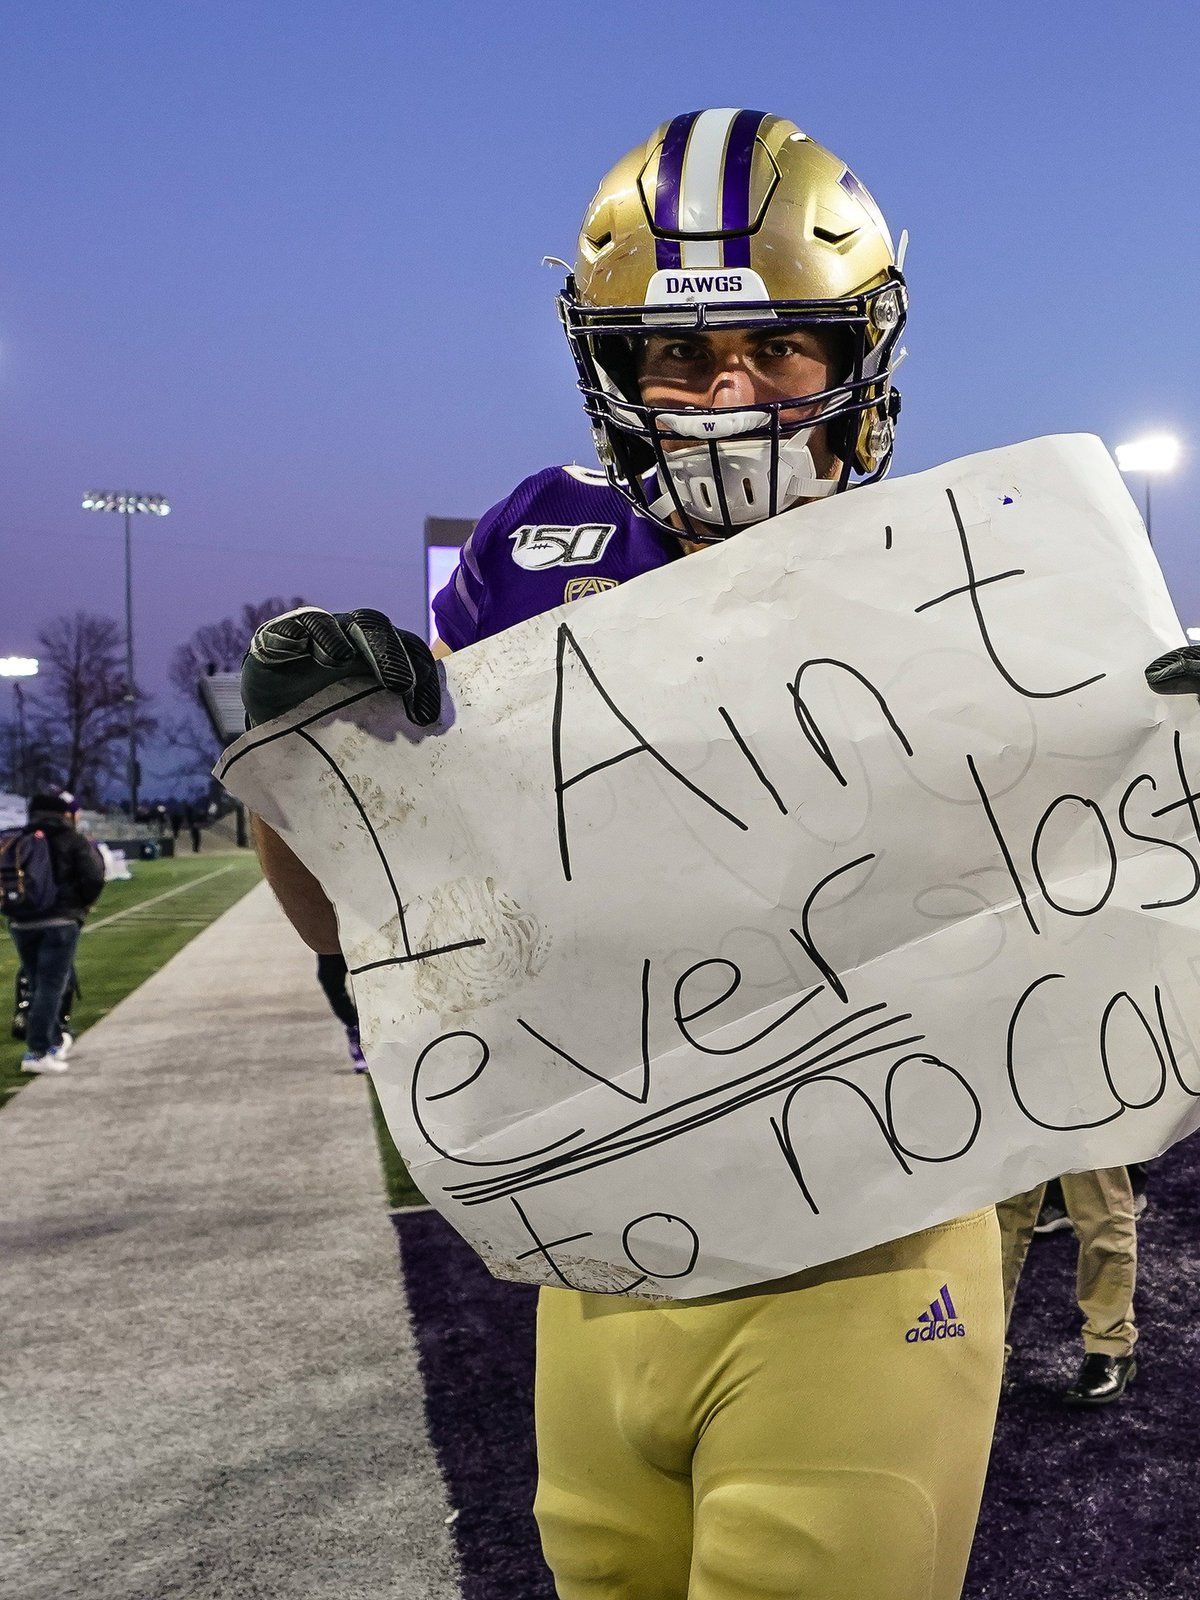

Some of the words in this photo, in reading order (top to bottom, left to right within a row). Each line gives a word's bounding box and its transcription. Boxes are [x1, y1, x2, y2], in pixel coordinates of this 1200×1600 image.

[666, 276, 743, 294] DAWGS
[702, 422, 716, 432] W
[509, 524, 616, 569] 150
[219, 684, 486, 974] I
[551, 487, 1107, 882] Ain't
[411, 853, 876, 1166] ever
[510, 1196, 700, 1296] to
[770, 1052, 982, 1216] no
[905, 1319, 966, 1343] adidas
